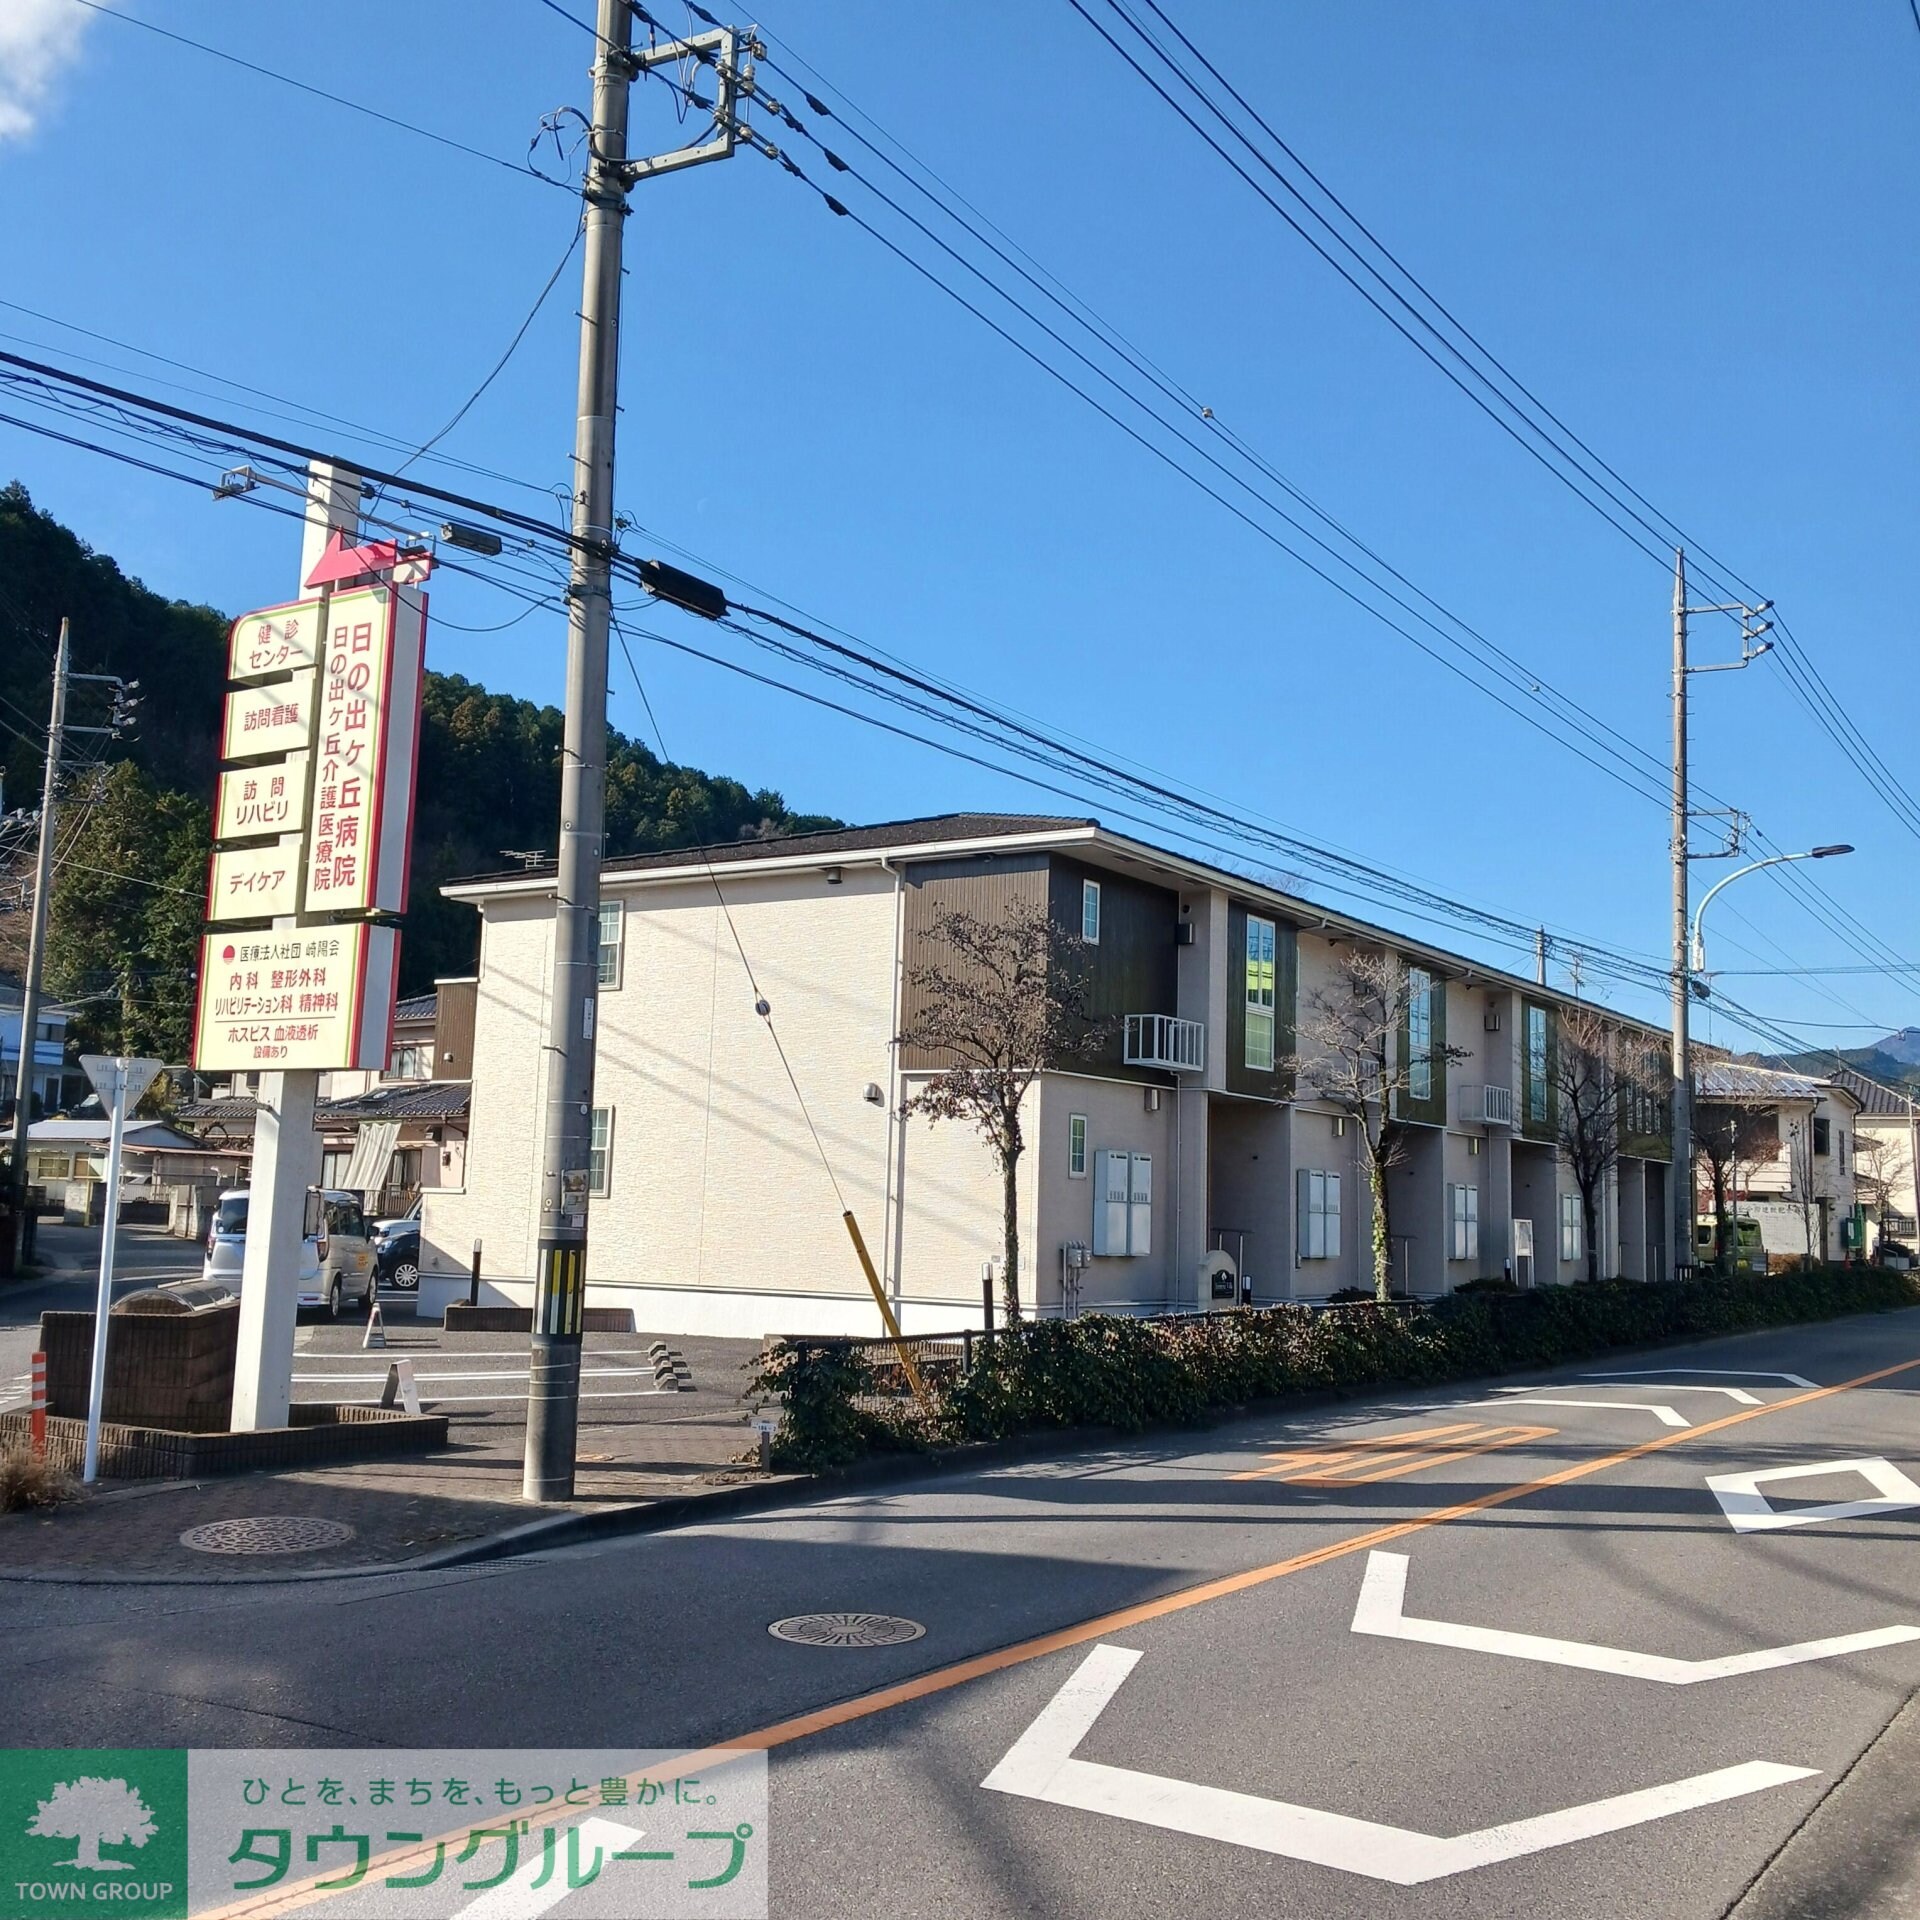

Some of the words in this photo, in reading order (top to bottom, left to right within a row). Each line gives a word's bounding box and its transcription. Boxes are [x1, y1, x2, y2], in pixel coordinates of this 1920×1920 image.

[249, 645, 304, 669] センター
[243, 703, 299, 732] 訪問看護
[236, 800, 290, 826] リハビリ
[230, 869, 286, 895] デイケア
[240, 943, 301, 962] 医療法人社団
[271, 967, 327, 989] 整形外科
[215, 994, 292, 1016] リハビリテーション科
[299, 992, 339, 1013] 精神科
[274, 1024, 319, 1042] 血液透析
[253, 1045, 288, 1059] 設備あり
